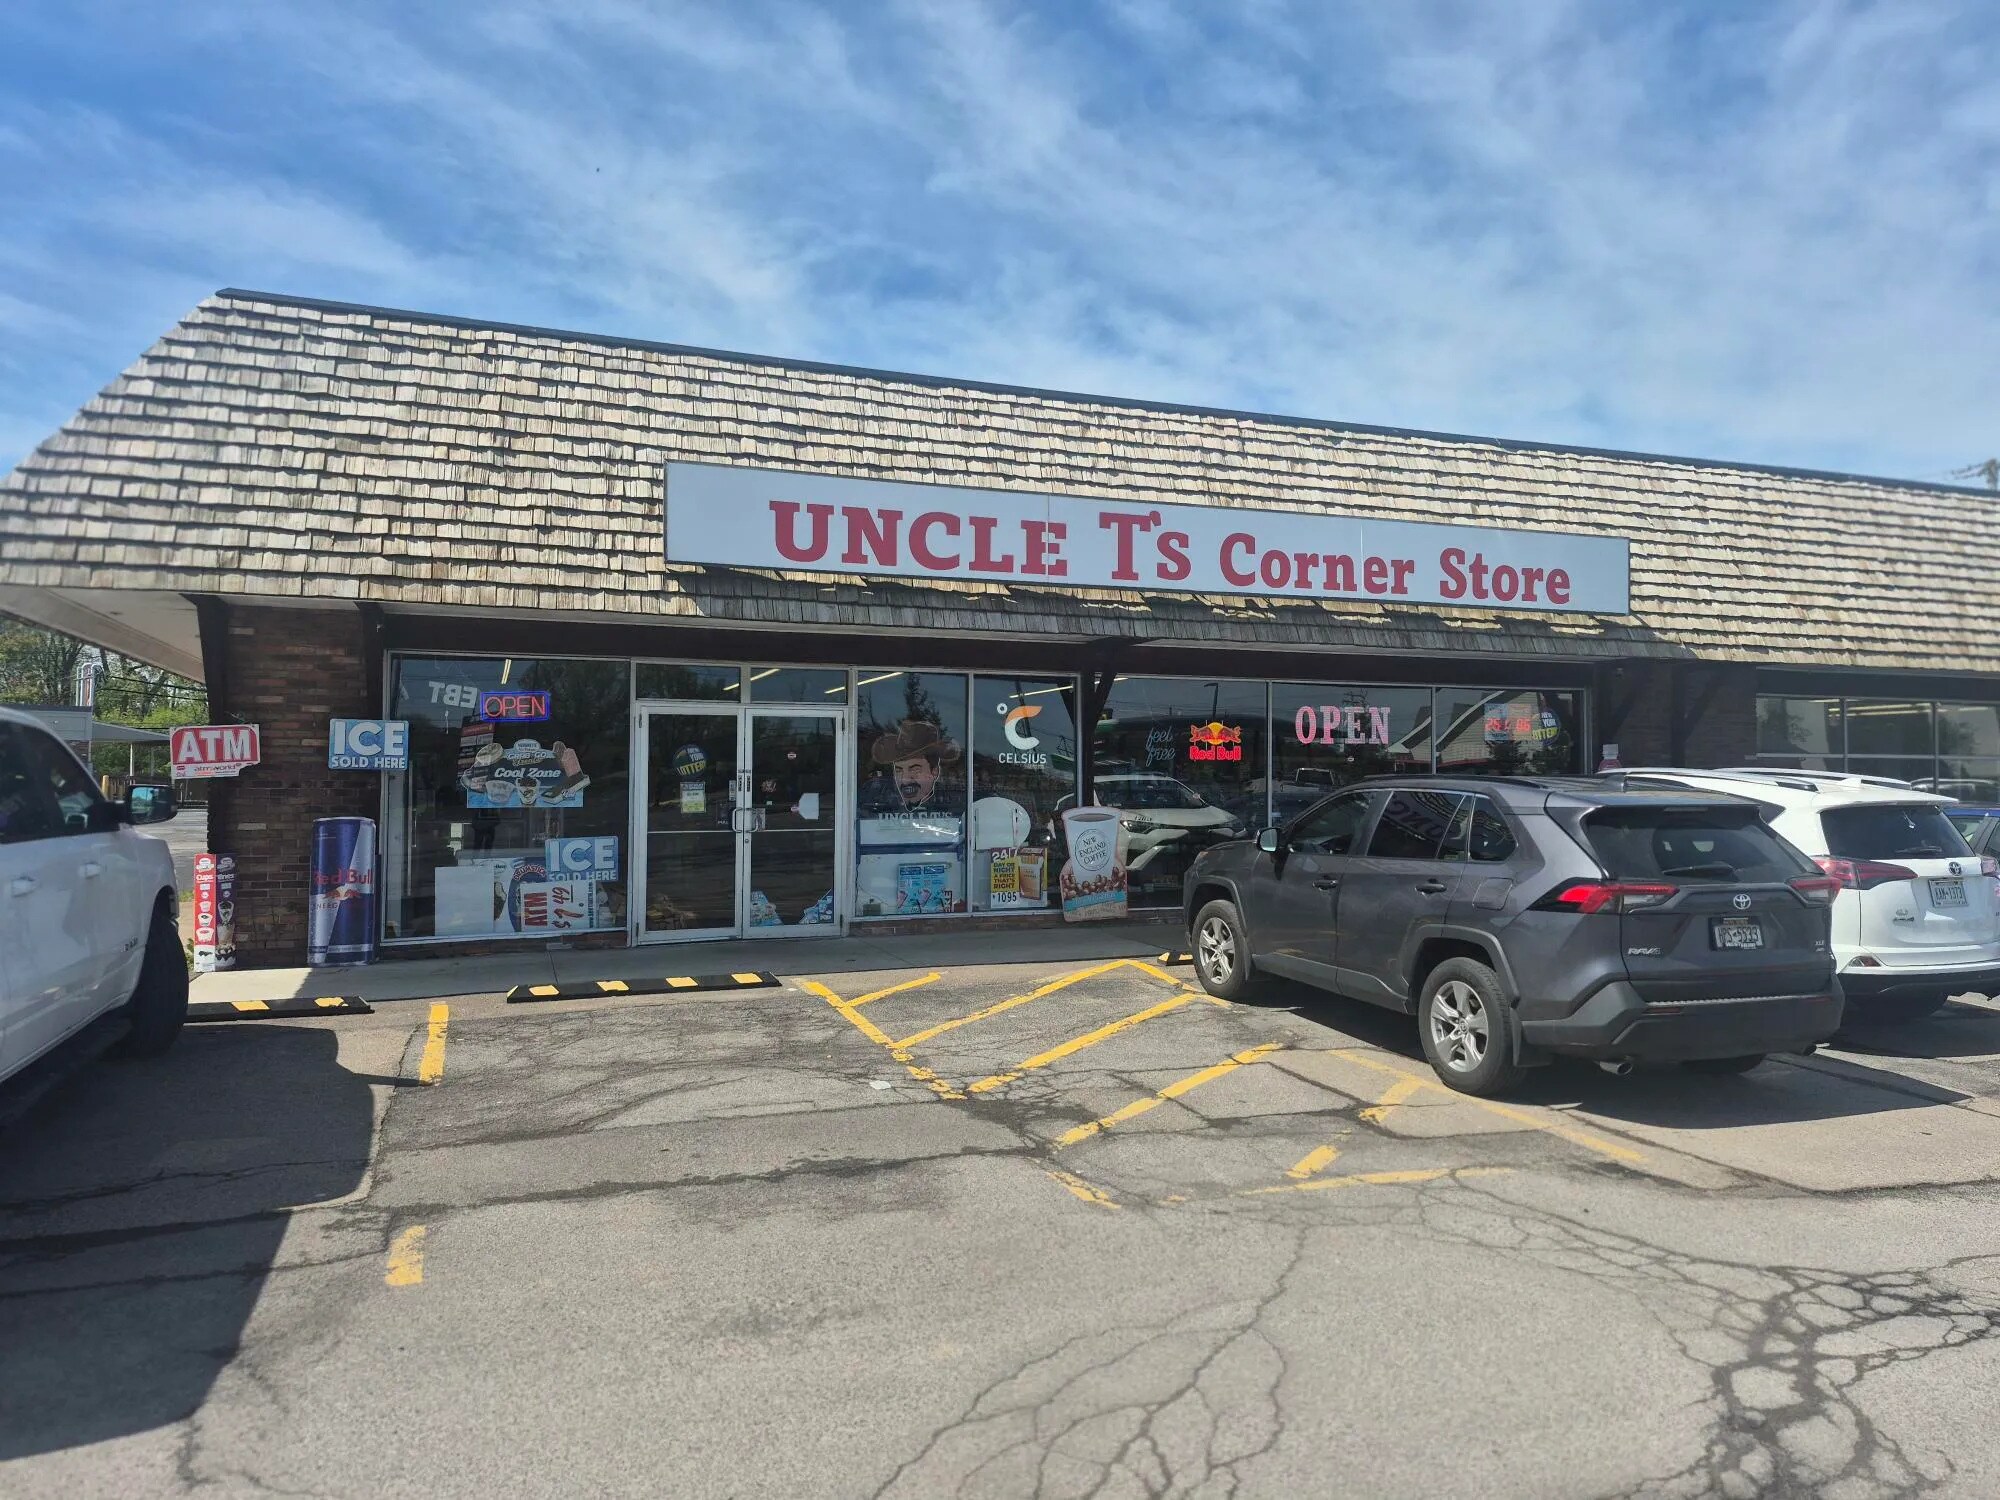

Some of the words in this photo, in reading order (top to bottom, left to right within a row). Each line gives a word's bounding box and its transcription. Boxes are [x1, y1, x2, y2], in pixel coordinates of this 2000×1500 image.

[769, 500, 1068, 577] UNCLE
[1099, 510, 1192, 581] T's
[1219, 532, 1415, 595] Corner
[1439, 547, 1571, 605] Store
[484, 696, 546, 717] OPEN
[1295, 705, 1391, 745] OPEN
[178, 730, 252, 762] ATM
[334, 721, 405, 756] ICE
[998, 752, 1047, 764] CELSIUS
[1189, 745, 1216, 760] Red
[1216, 745, 1241, 760] Bull
[331, 757, 369, 768] SOLD
[374, 757, 406, 769] HERE
[494, 767, 526, 778] Cool
[527, 767, 561, 778] Zone
[1079, 841, 1106, 857] ENGLAND
[1082, 836, 1097, 847] NEW
[551, 839, 616, 872] ICE
[1083, 849, 1108, 865] COFFEE
[346, 868, 373, 884] Bull
[524, 892, 548, 926] ATM
